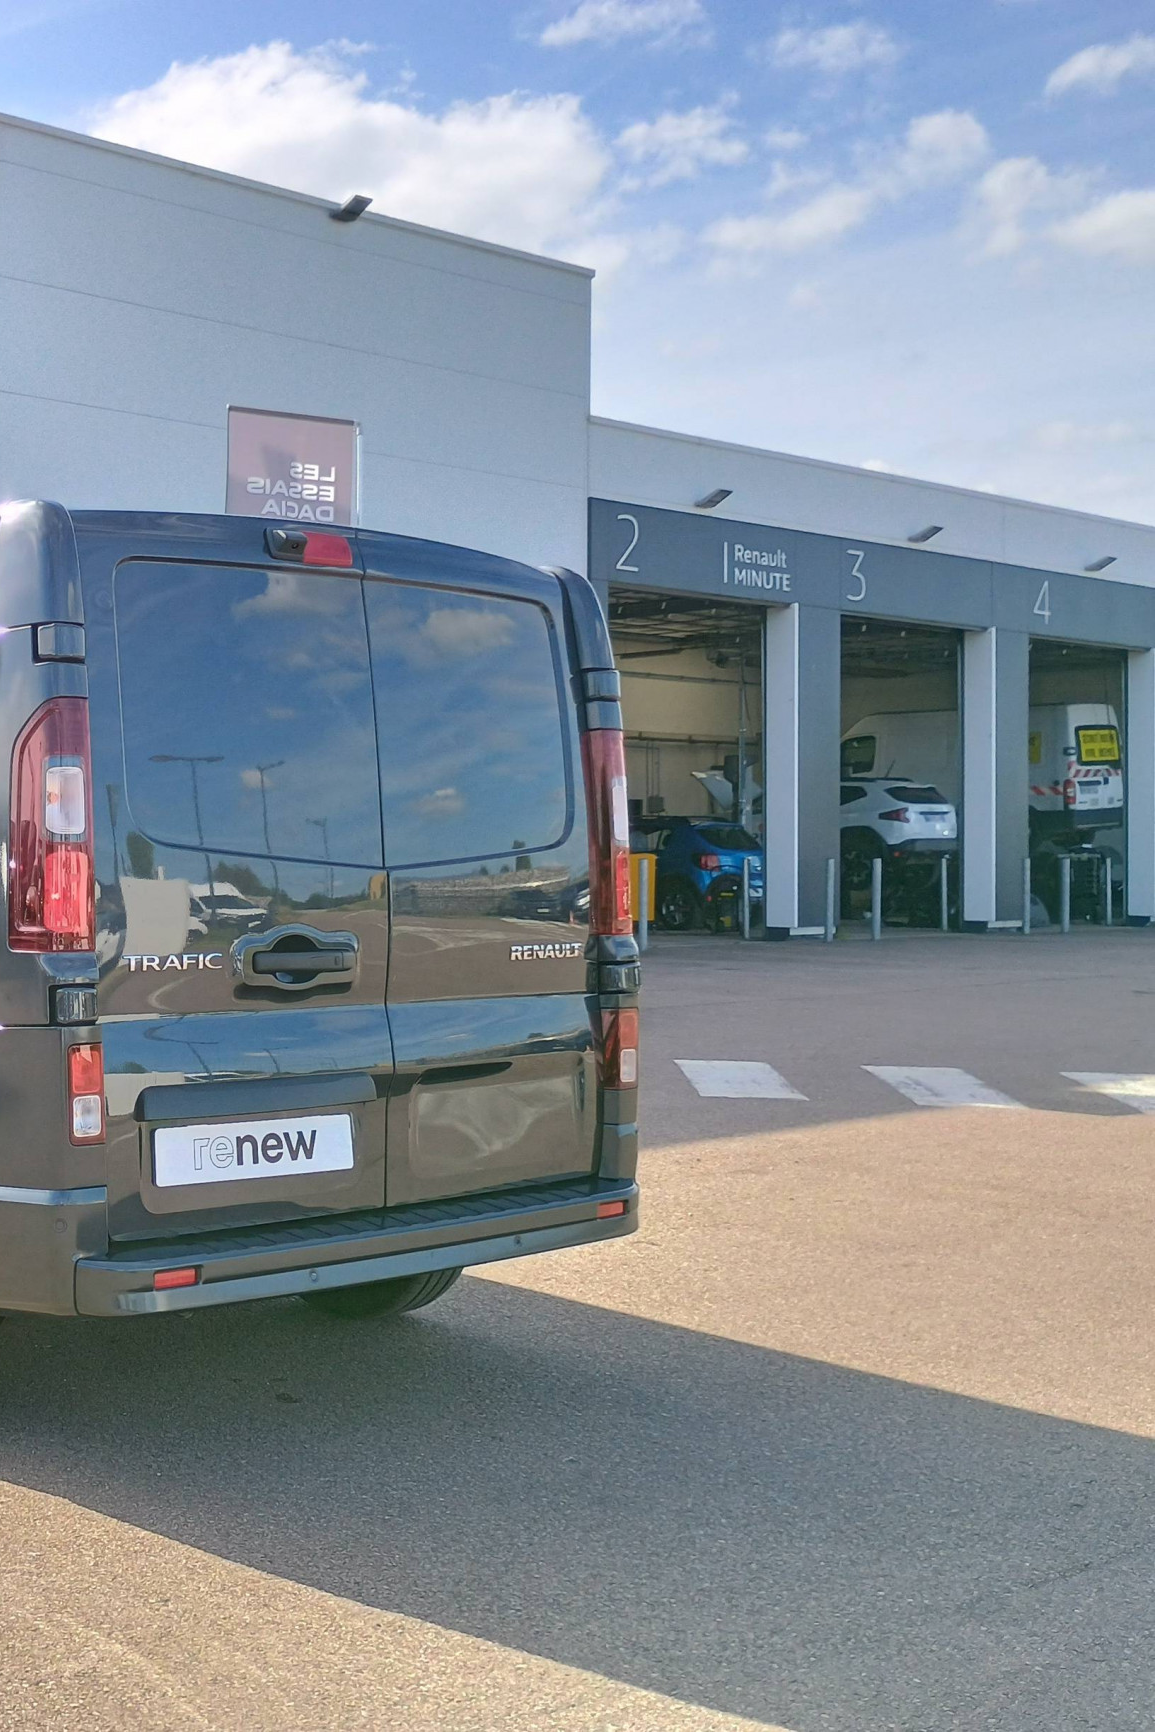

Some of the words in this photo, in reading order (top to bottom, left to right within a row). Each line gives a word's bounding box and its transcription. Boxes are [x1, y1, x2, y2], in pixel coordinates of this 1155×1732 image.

[615, 513, 640, 572] 2
[734, 543, 787, 569] Renault
[734, 567, 791, 592] MINUTE
[846, 549, 867, 601] 3
[1033, 580, 1051, 625] 4
[122, 952, 223, 972] TRAFIC
[510, 942, 583, 960] RENAULT
[193, 1129, 317, 1171] renew
